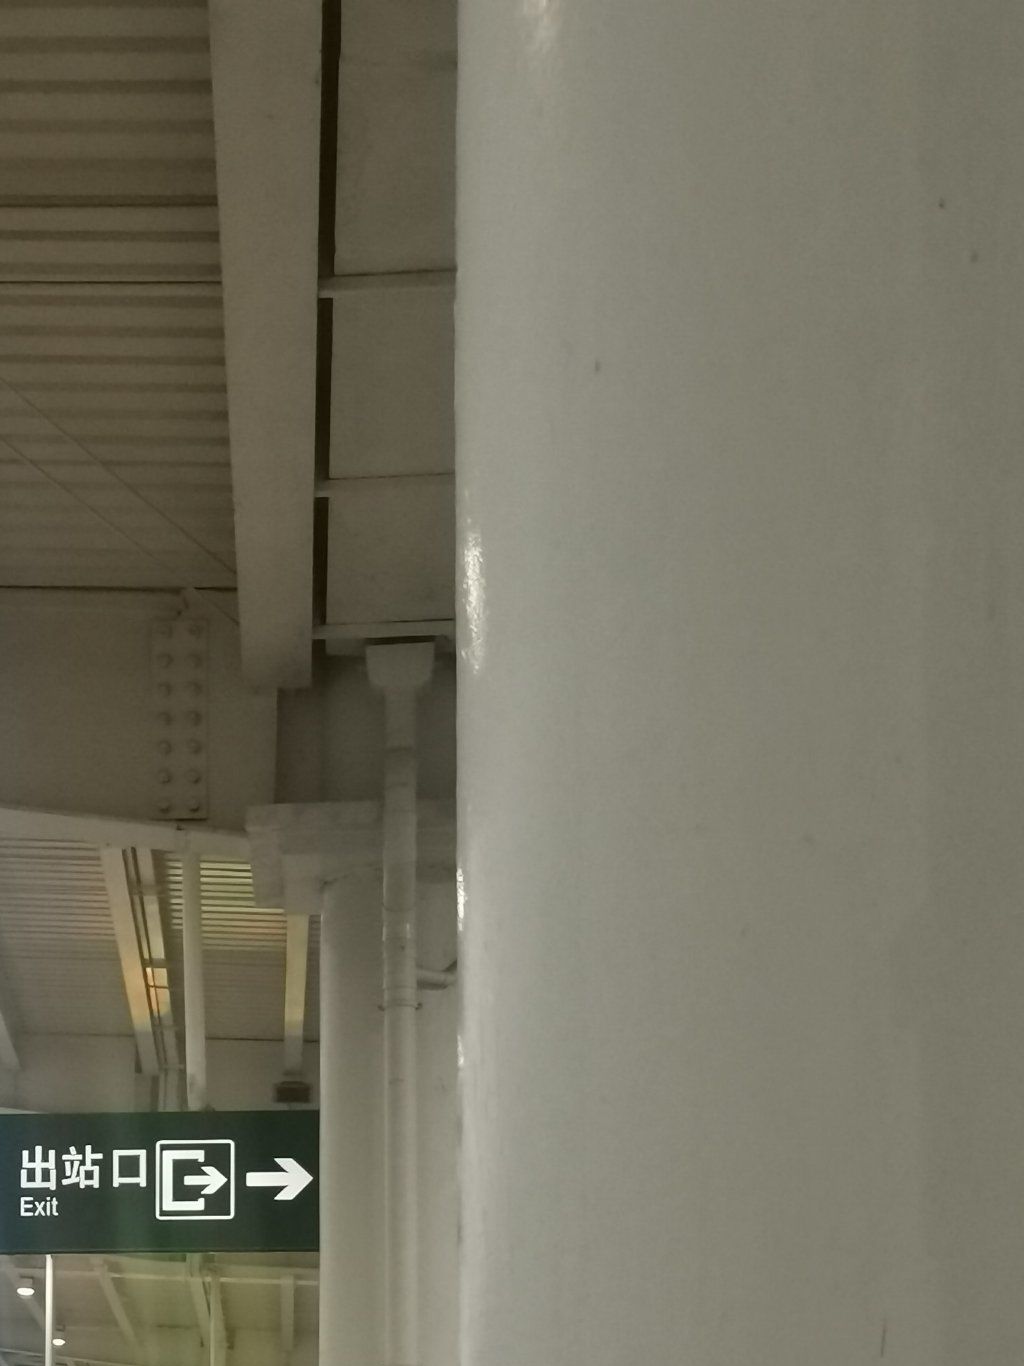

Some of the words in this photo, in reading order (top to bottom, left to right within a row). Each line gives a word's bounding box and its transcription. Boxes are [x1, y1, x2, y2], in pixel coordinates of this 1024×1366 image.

[20, 1145, 147, 1190] 出站口
[20, 1197, 59, 1217] Exit
